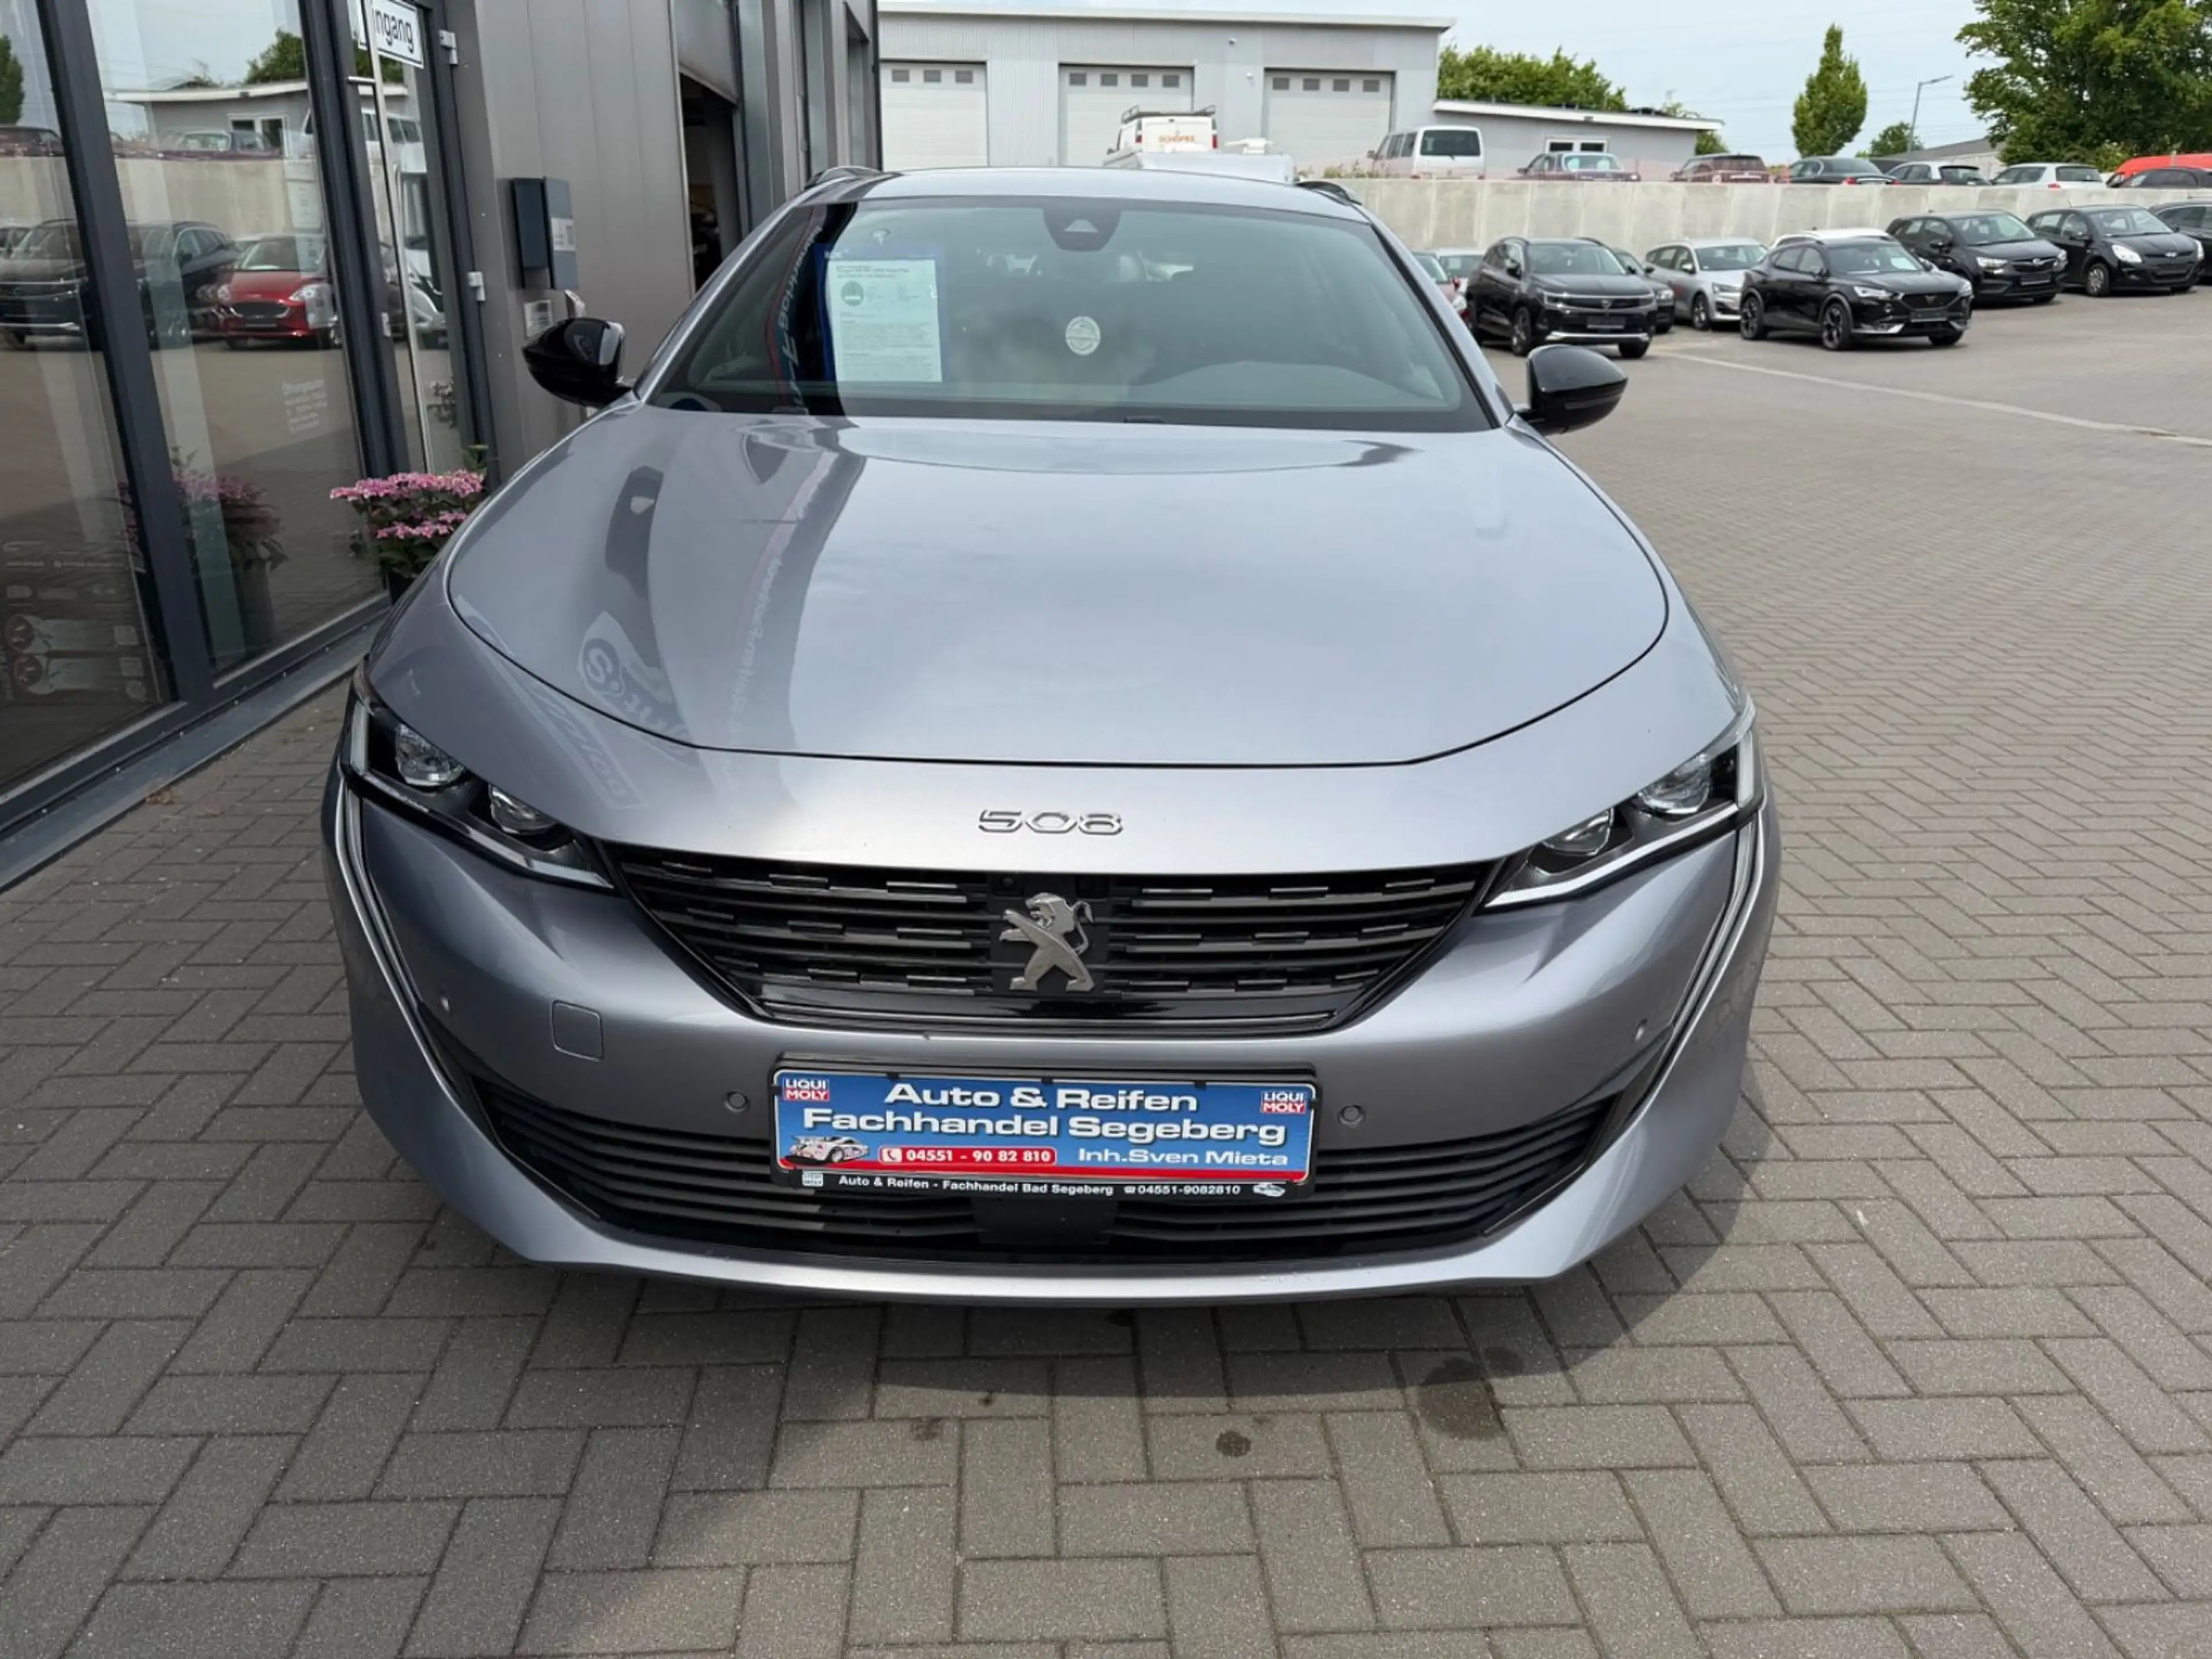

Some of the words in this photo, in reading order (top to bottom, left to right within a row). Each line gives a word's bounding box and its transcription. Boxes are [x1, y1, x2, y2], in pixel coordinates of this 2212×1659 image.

[978, 809, 1124, 836] 508
[785, 1078, 827, 1090] LIQUI
[785, 1090, 828, 1101] MOLY
[884, 1083, 1001, 1108] Auto
[1010, 1086, 1048, 1108] &
[1056, 1088, 1198, 1112] Reifen
[1263, 1092, 1305, 1102] LIQUI
[1262, 1103, 1305, 1113] MOLY
[803, 1108, 1058, 1136] Fachhandel
[1069, 1116, 1286, 1146] Segeberg
[906, 1150, 953, 1162] 04551
[972, 1150, 993, 1162] 90
[997, 1150, 1018, 1162] 82
[1022, 1150, 1050, 1162] 810
[1078, 1148, 1199, 1164] Inh.Sven
[1206, 1150, 1289, 1166] Mieta
[839, 1175, 869, 1187] Auto
[873, 1177, 884, 1187] &
[887, 1177, 929, 1190] Reifen
[942, 1179, 1018, 1193] Fachhandel
[1022, 1182, 1048, 1193] Bad
[1051, 1184, 1114, 1196] Segeberg
